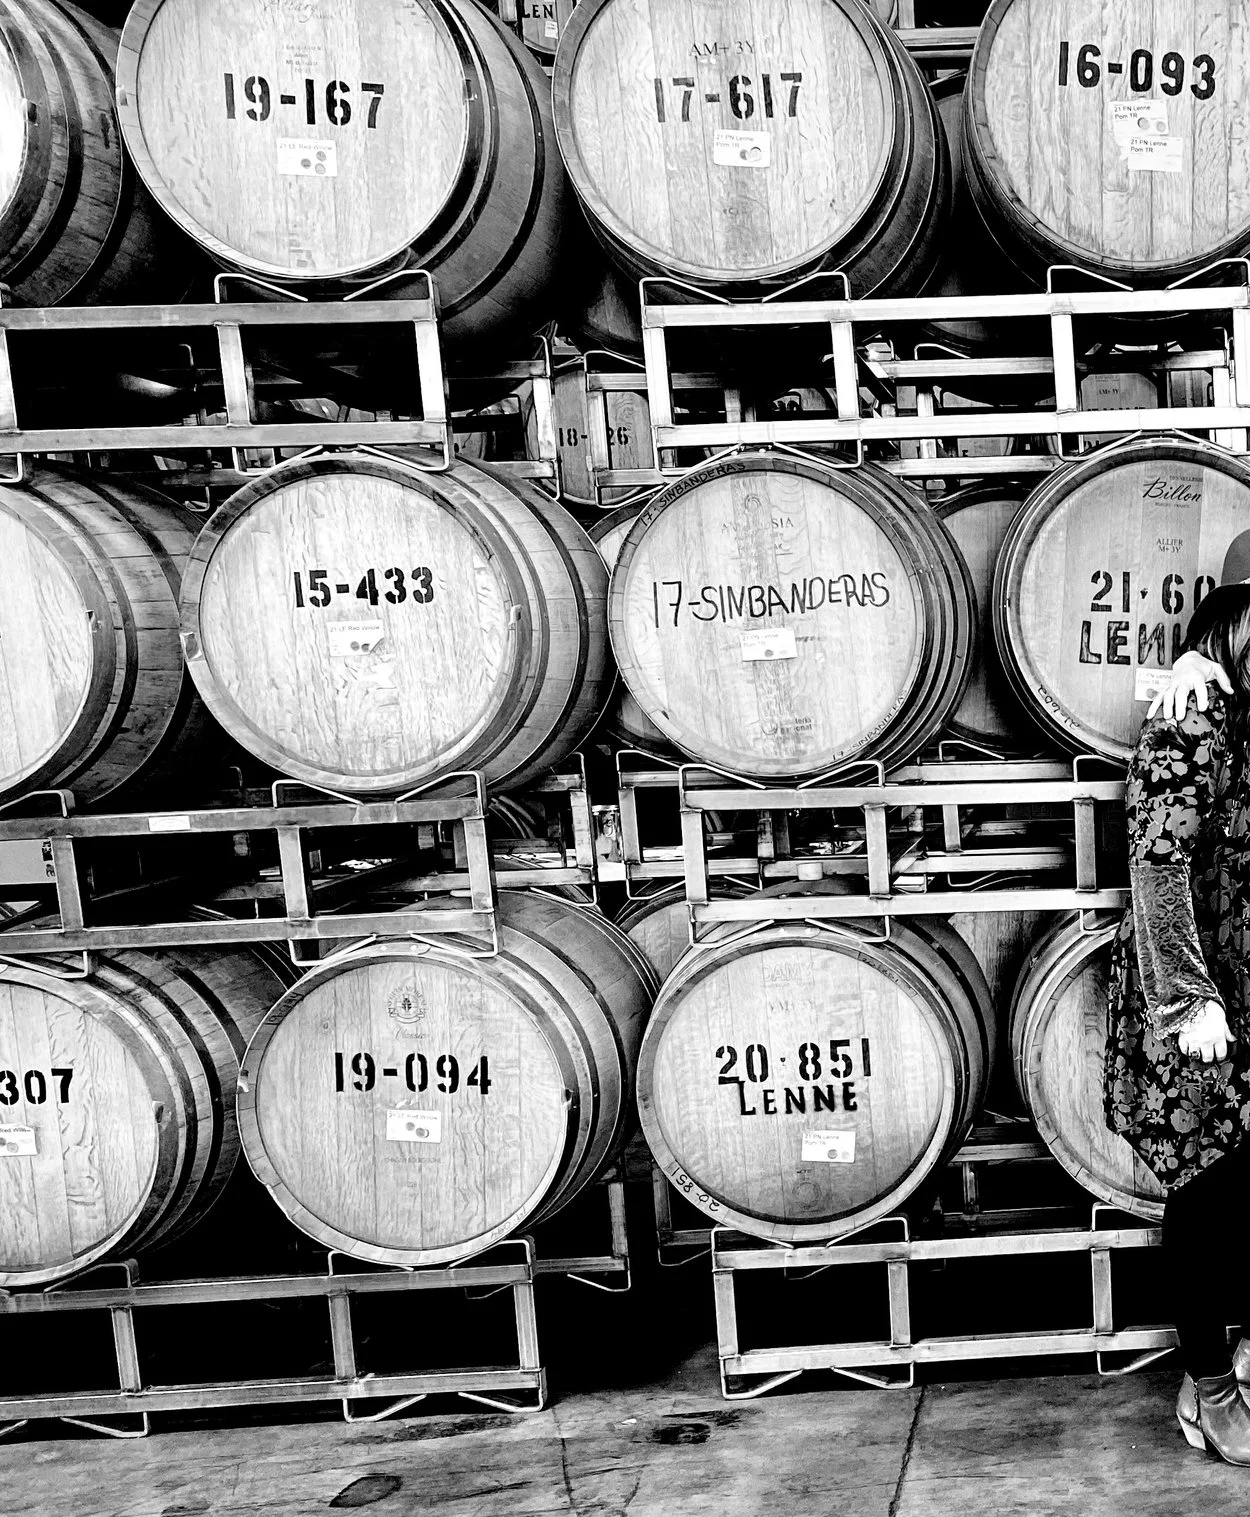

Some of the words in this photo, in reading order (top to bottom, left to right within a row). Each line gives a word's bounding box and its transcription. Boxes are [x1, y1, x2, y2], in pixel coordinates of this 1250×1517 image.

[735, 41, 755, 54] 3Y
[1058, 41, 1217, 100] 16-093
[223, 73, 385, 129] 19-167
[654, 72, 802, 123] 17-617
[1143, 477, 1202, 502] Billon
[294, 567, 434, 608] 15-433
[653, 573, 891, 628] 17-SINBANDERAS
[1079, 621, 1188, 665] LEN
[0, 1068, 73, 1106] 307
[334, 1051, 493, 1095] 19-094
[739, 1080, 858, 1116] LENNE
[671, 1167, 720, 1212] 20-851
